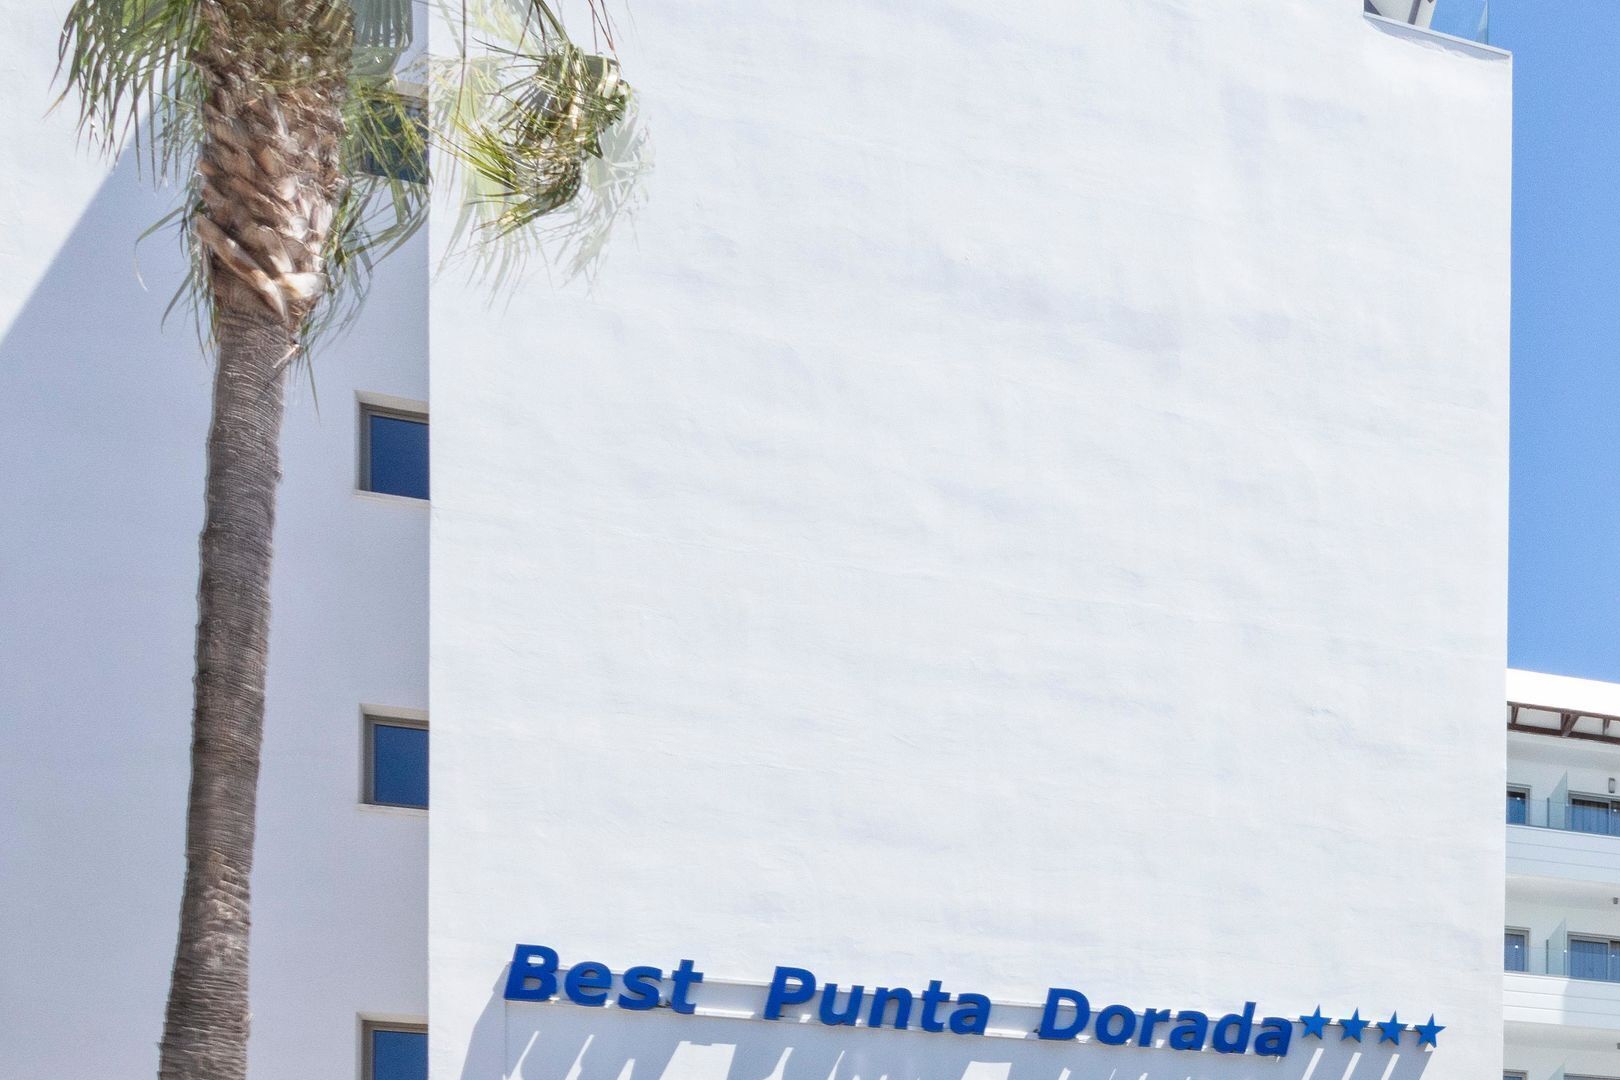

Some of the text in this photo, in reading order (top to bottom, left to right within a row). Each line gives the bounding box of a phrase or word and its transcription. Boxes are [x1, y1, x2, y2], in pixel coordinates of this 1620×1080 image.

[504, 943, 1296, 1057] Best Punta Dorada
